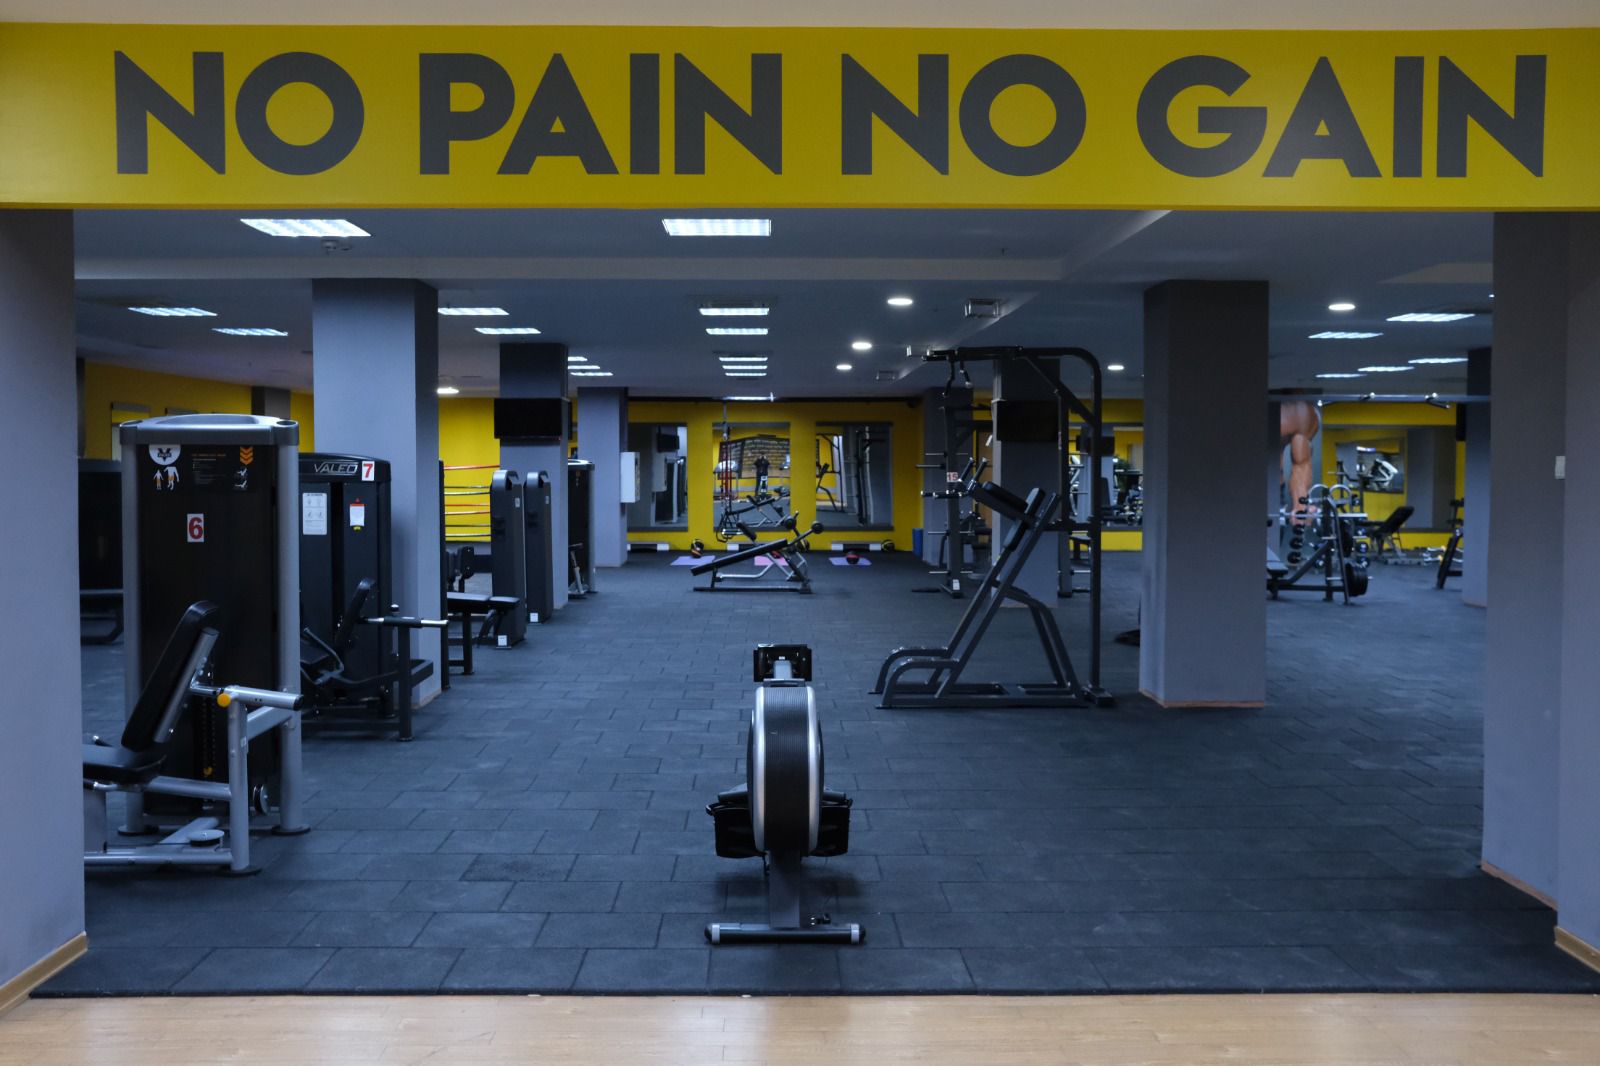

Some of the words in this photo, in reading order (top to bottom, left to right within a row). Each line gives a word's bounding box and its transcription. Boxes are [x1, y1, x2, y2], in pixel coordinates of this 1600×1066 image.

[116, 51, 364, 176] NO
[420, 53, 782, 175] PAIN
[842, 54, 1086, 176] NO
[1138, 55, 1546, 178] GAIN
[362, 463, 374, 478] 7
[188, 516, 204, 540] 6
